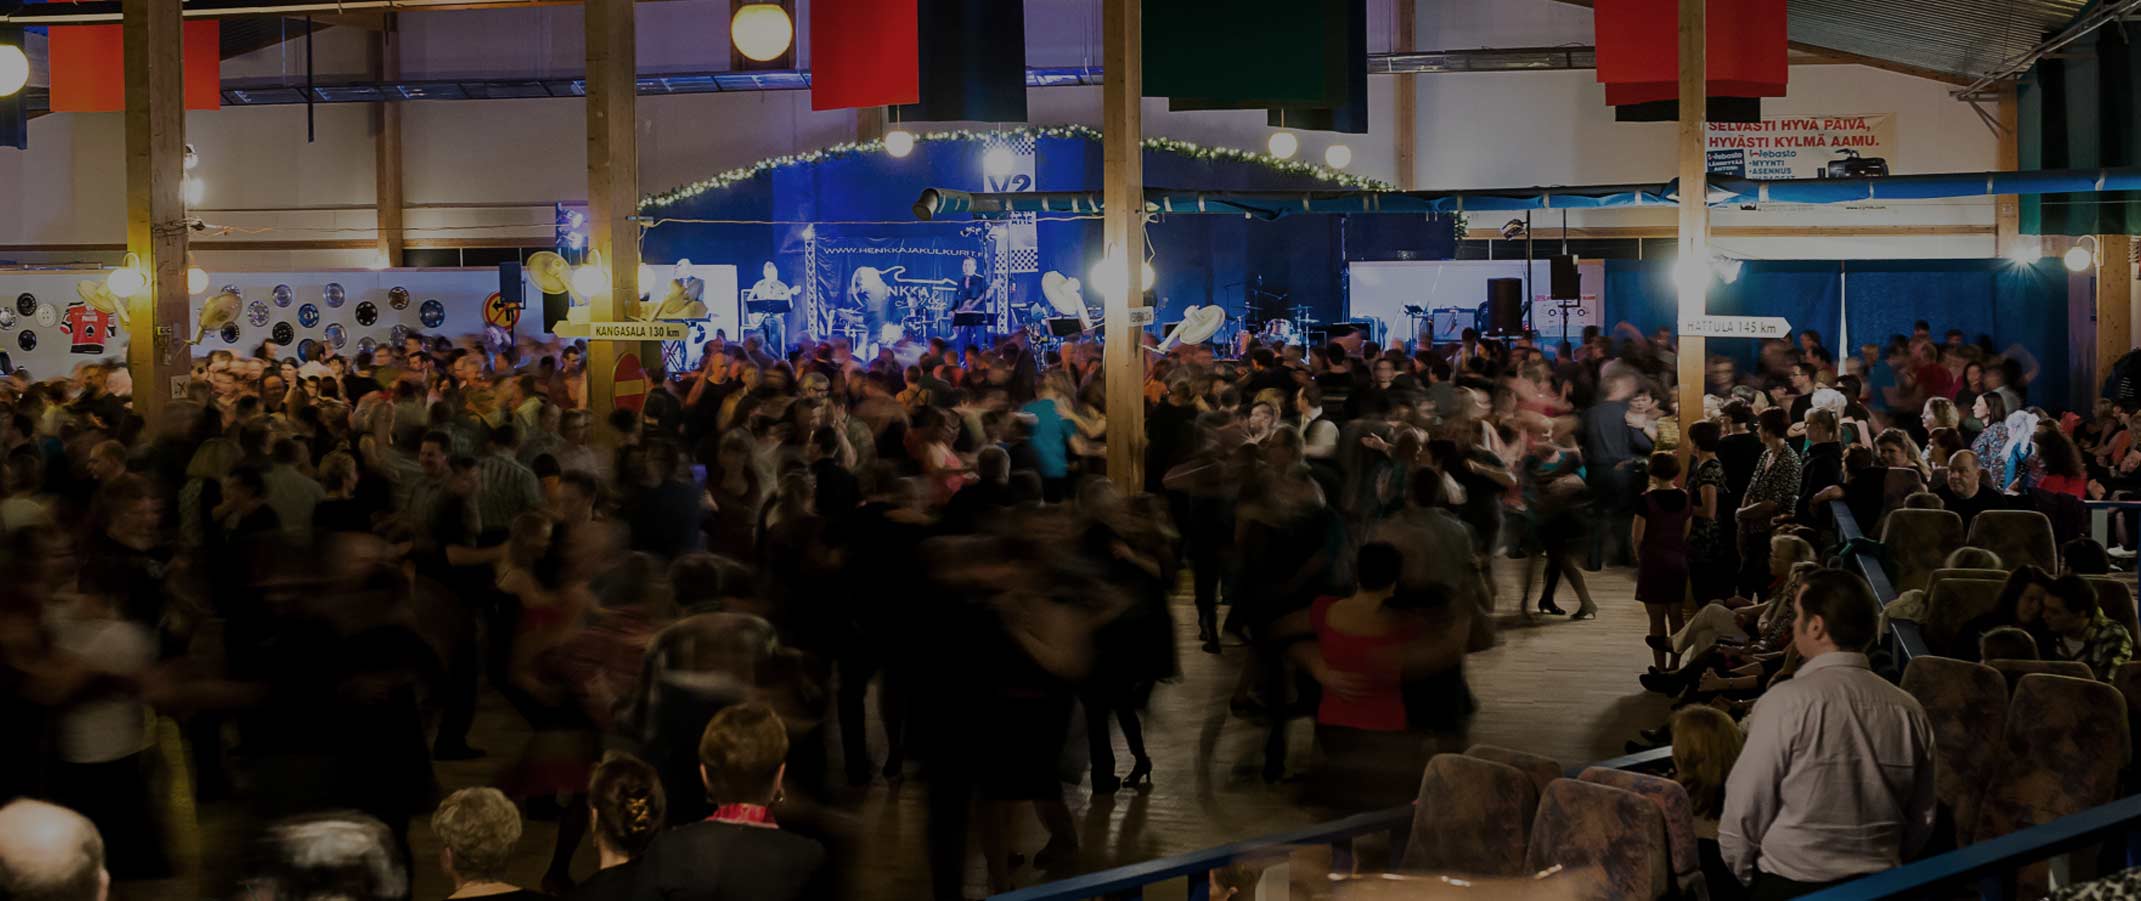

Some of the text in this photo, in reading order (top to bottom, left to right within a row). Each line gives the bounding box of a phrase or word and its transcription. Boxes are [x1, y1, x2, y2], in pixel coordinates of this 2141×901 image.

[1781, 117, 1820, 131] HYVÄ
[1823, 116, 1872, 132] PÄIVÄ,
[1708, 133, 1880, 148] HYVÄSTI KYLMÄ AAMU.
[823, 246, 984, 257] WWW.HENKKAJAKULKURIT.F
[595, 326, 680, 337] KANGASALA 130 km
[1738, 321, 1757, 333] 145
[1760, 322, 1777, 334] km
